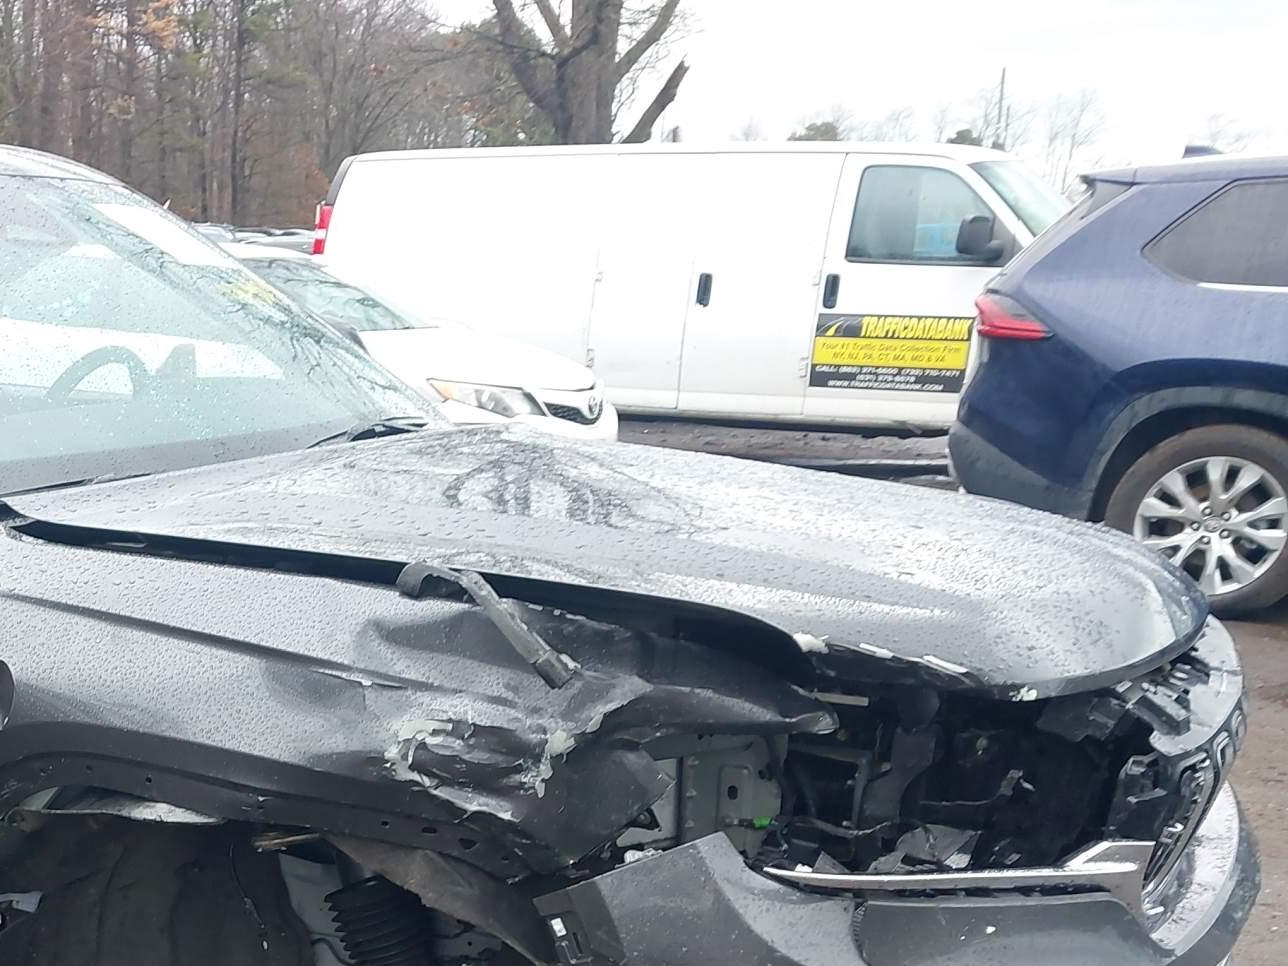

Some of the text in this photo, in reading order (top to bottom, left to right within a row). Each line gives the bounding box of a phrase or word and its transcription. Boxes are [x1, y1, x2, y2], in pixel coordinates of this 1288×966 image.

[861, 316, 973, 340] TRAFFICDATABANK
[822, 342, 839, 350] Your
[853, 343, 876, 351] Traffic
[878, 343, 897, 351] Data
